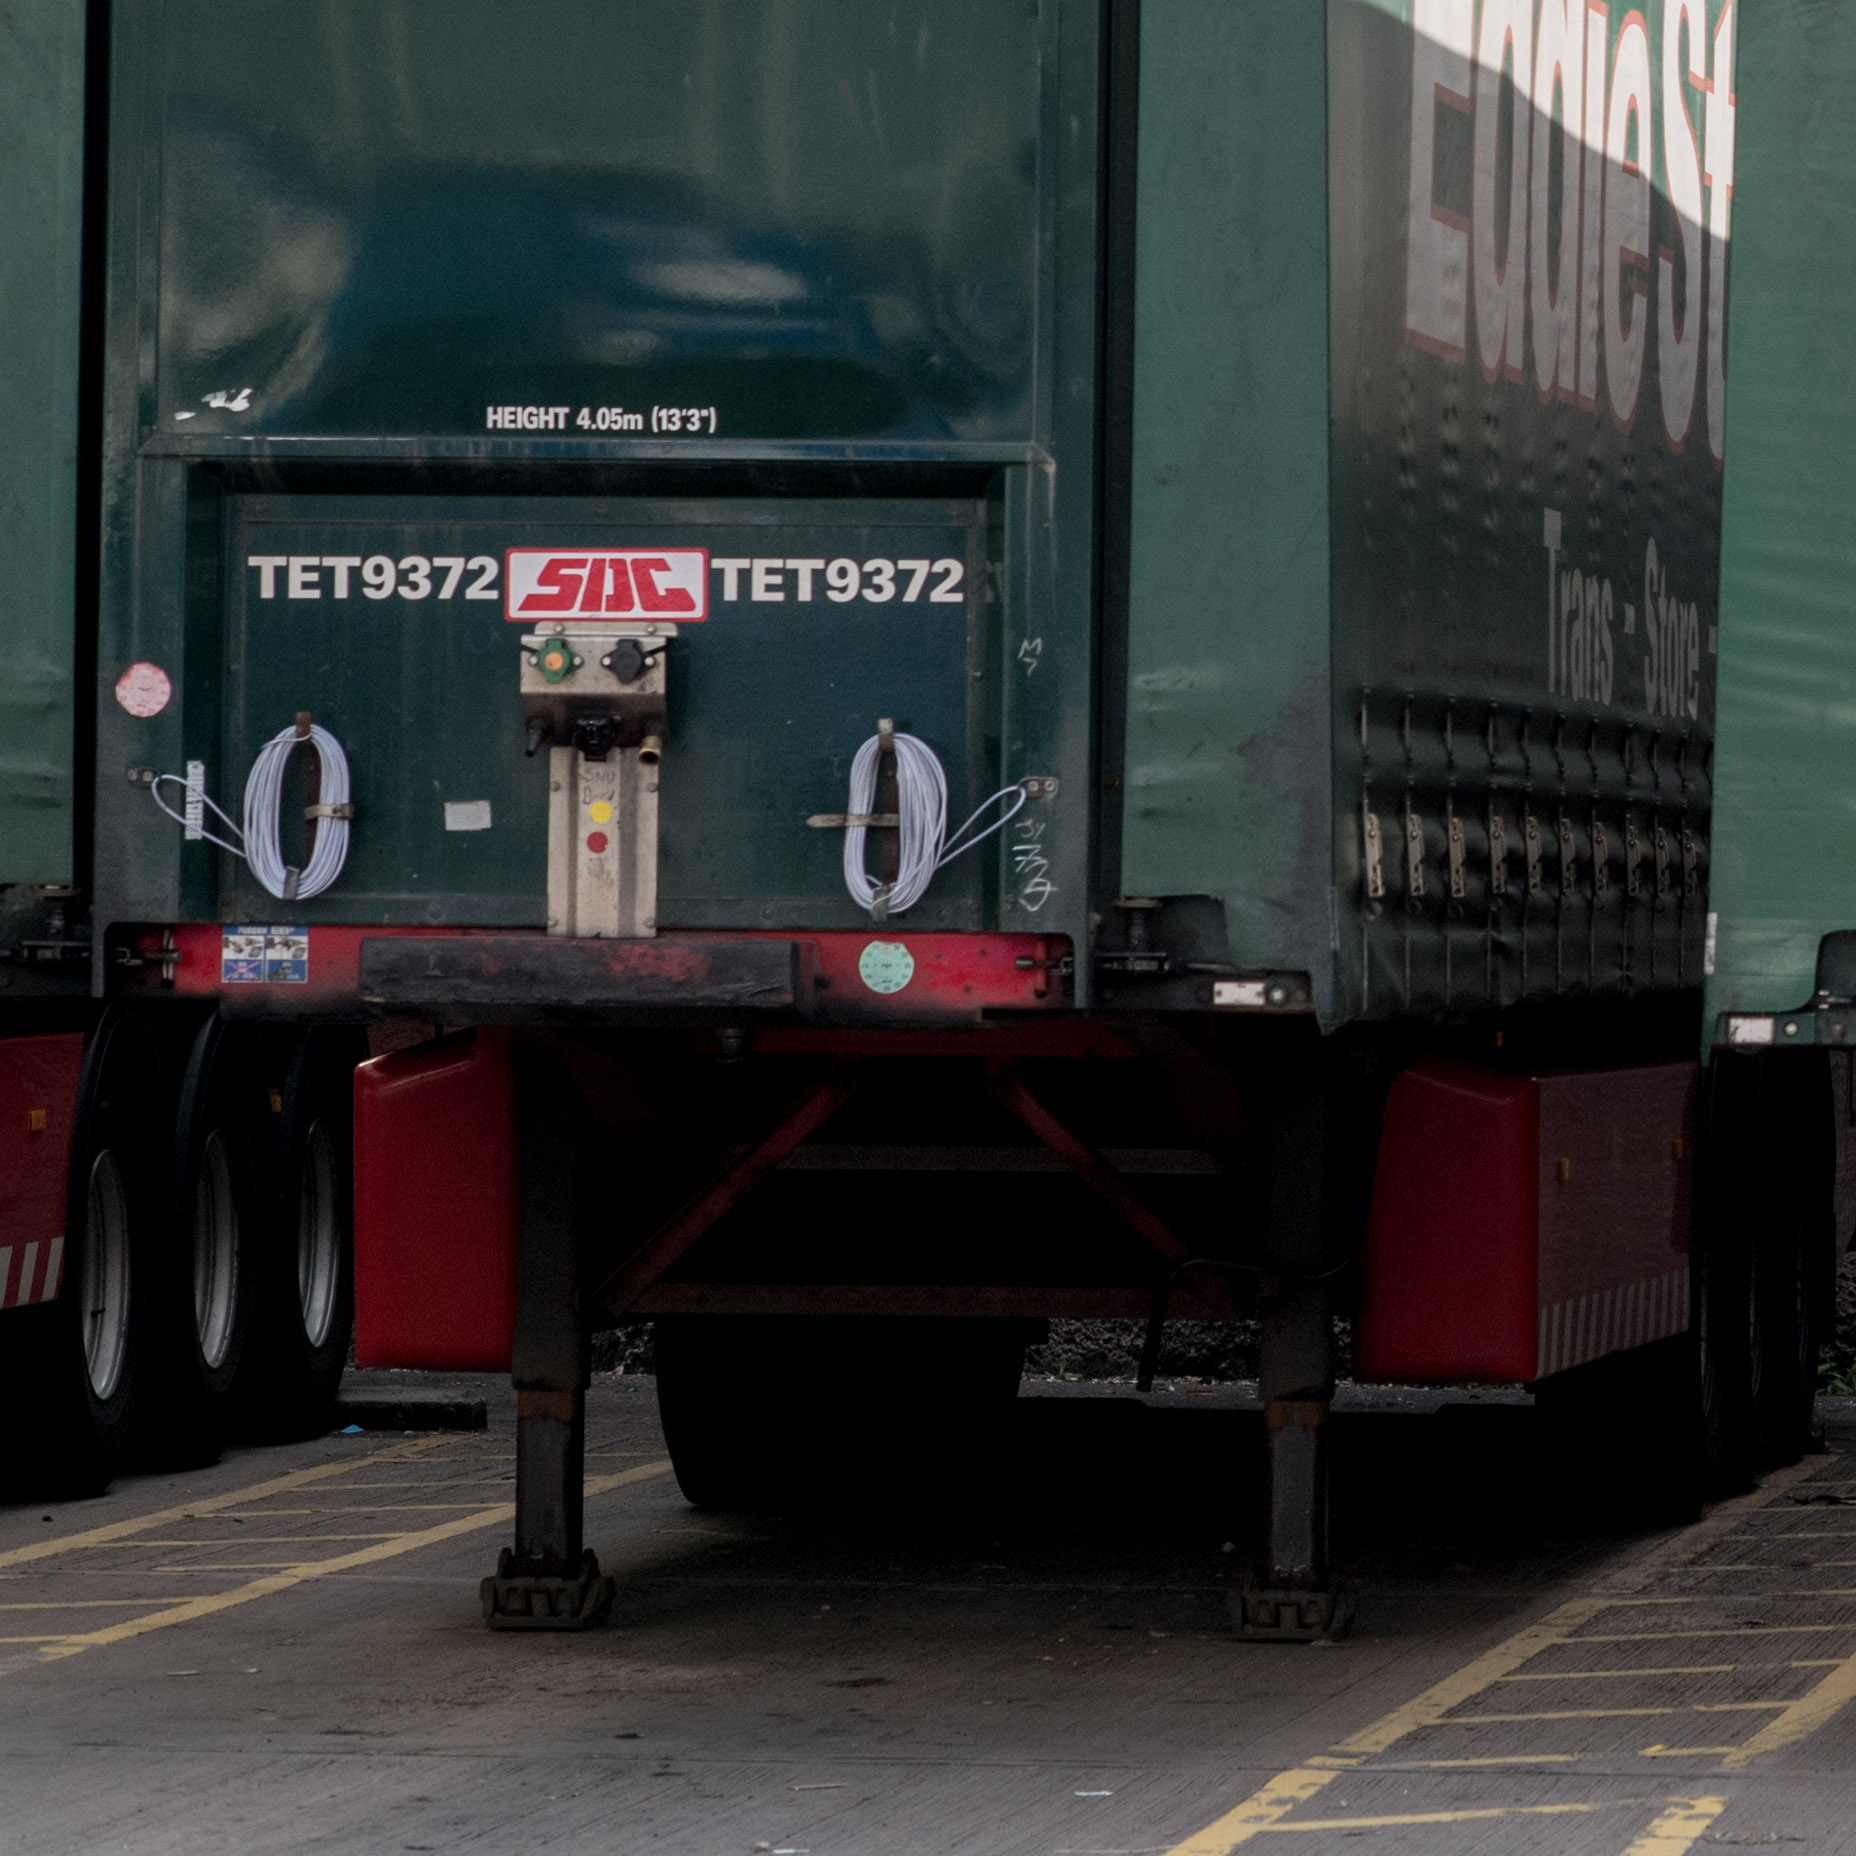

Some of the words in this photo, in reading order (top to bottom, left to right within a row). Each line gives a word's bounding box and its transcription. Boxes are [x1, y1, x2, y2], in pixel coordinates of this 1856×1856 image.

[486, 406, 570, 430] HEIGHT
[576, 406, 644, 431] 4.05m
[247, 554, 500, 601] TET9372
[517, 557, 697, 613] SDC
[709, 557, 965, 603] TET9372
[1542, 506, 1615, 708] Trans
[1643, 536, 1700, 721] Store
